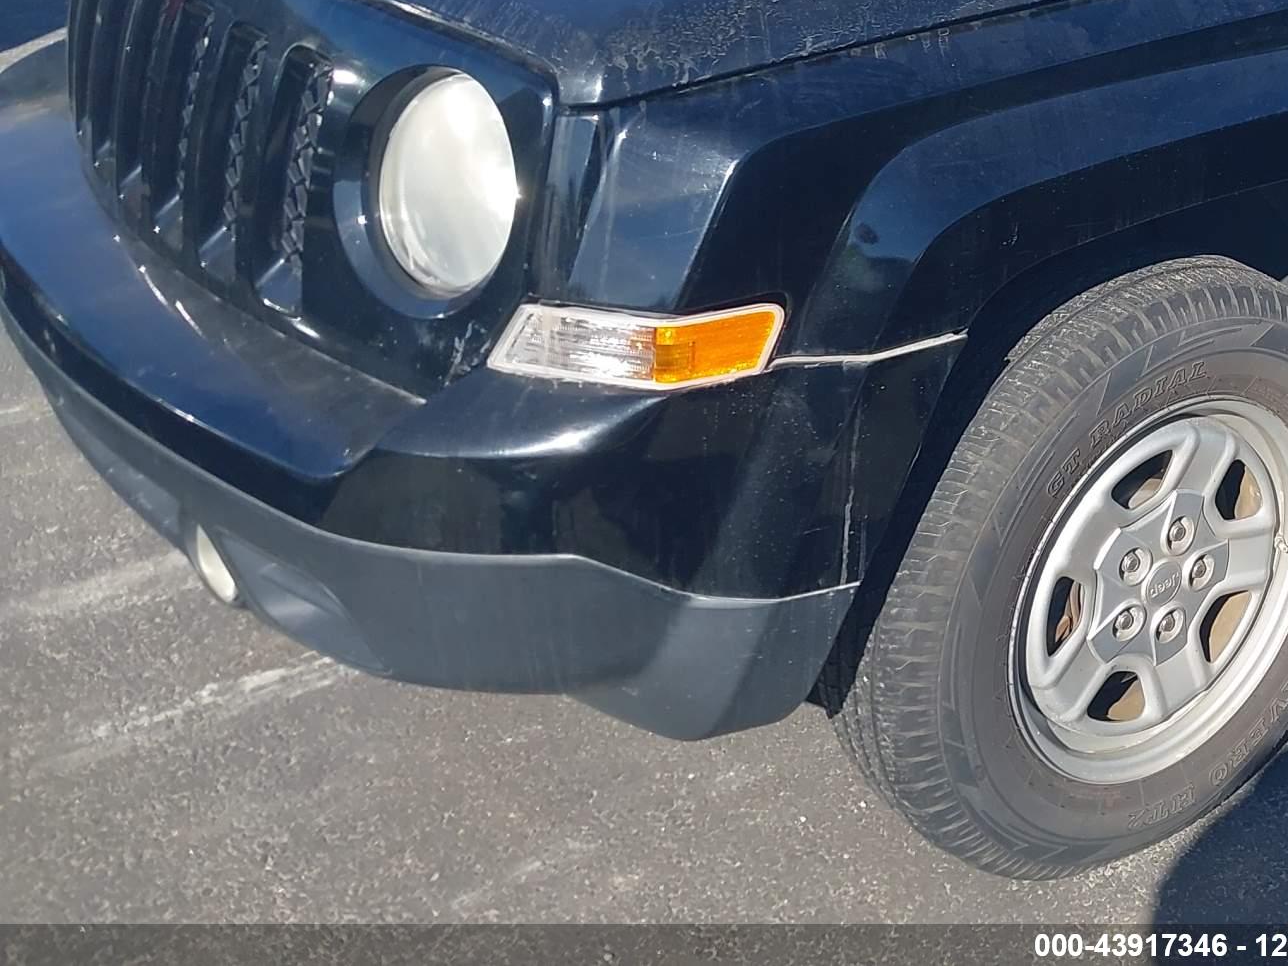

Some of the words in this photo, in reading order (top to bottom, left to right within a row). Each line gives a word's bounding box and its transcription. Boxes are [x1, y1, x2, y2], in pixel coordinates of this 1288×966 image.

[1047, 448, 1081, 499] GT
[1089, 361, 1207, 449] RADIAL
[1150, 571, 1179, 599] Jeep
